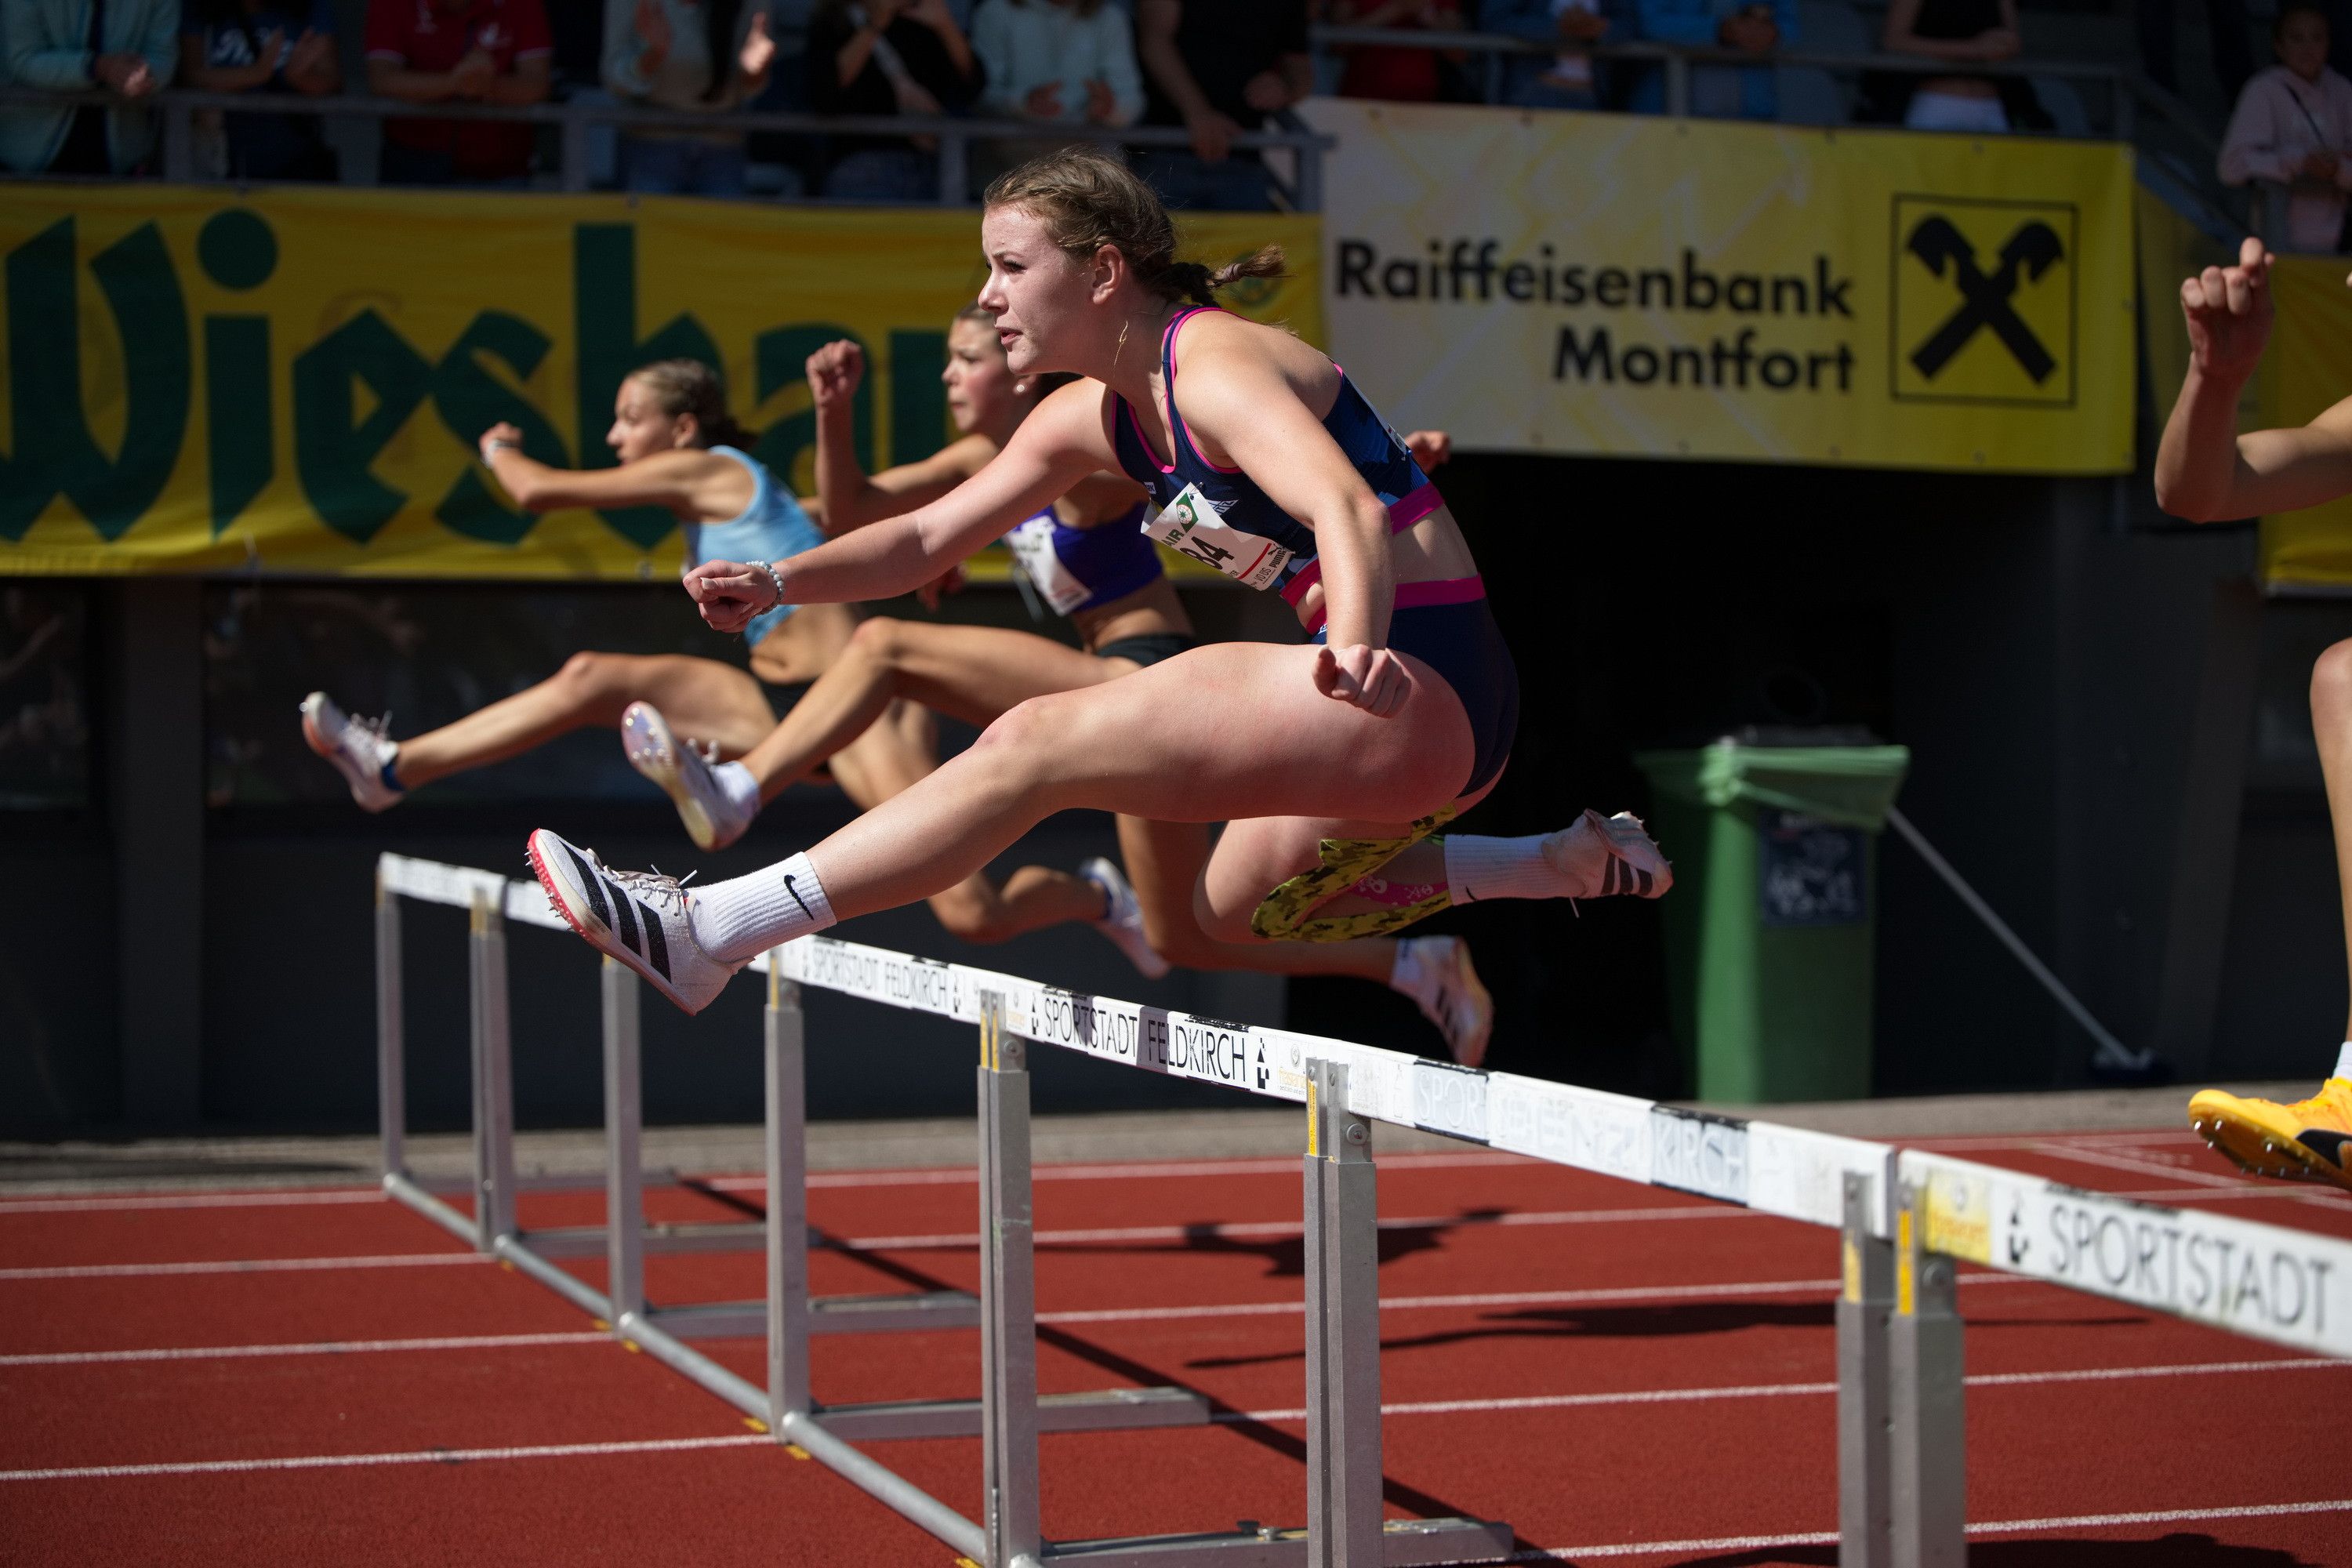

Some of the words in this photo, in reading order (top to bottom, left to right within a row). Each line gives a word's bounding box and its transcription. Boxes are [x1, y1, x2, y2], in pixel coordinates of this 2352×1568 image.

[1334, 238, 1855, 318] Raiffeisenbank
[1553, 325, 1854, 392] Montfort
[1180, 535, 1236, 570] 84
[884, 960, 947, 1010] FELDKIRCH
[1044, 997, 1138, 1058] SPORTSTADT
[1147, 1018, 1246, 1082] FELDKIRCH
[2049, 1205, 2335, 1334] SPORTSTADT
